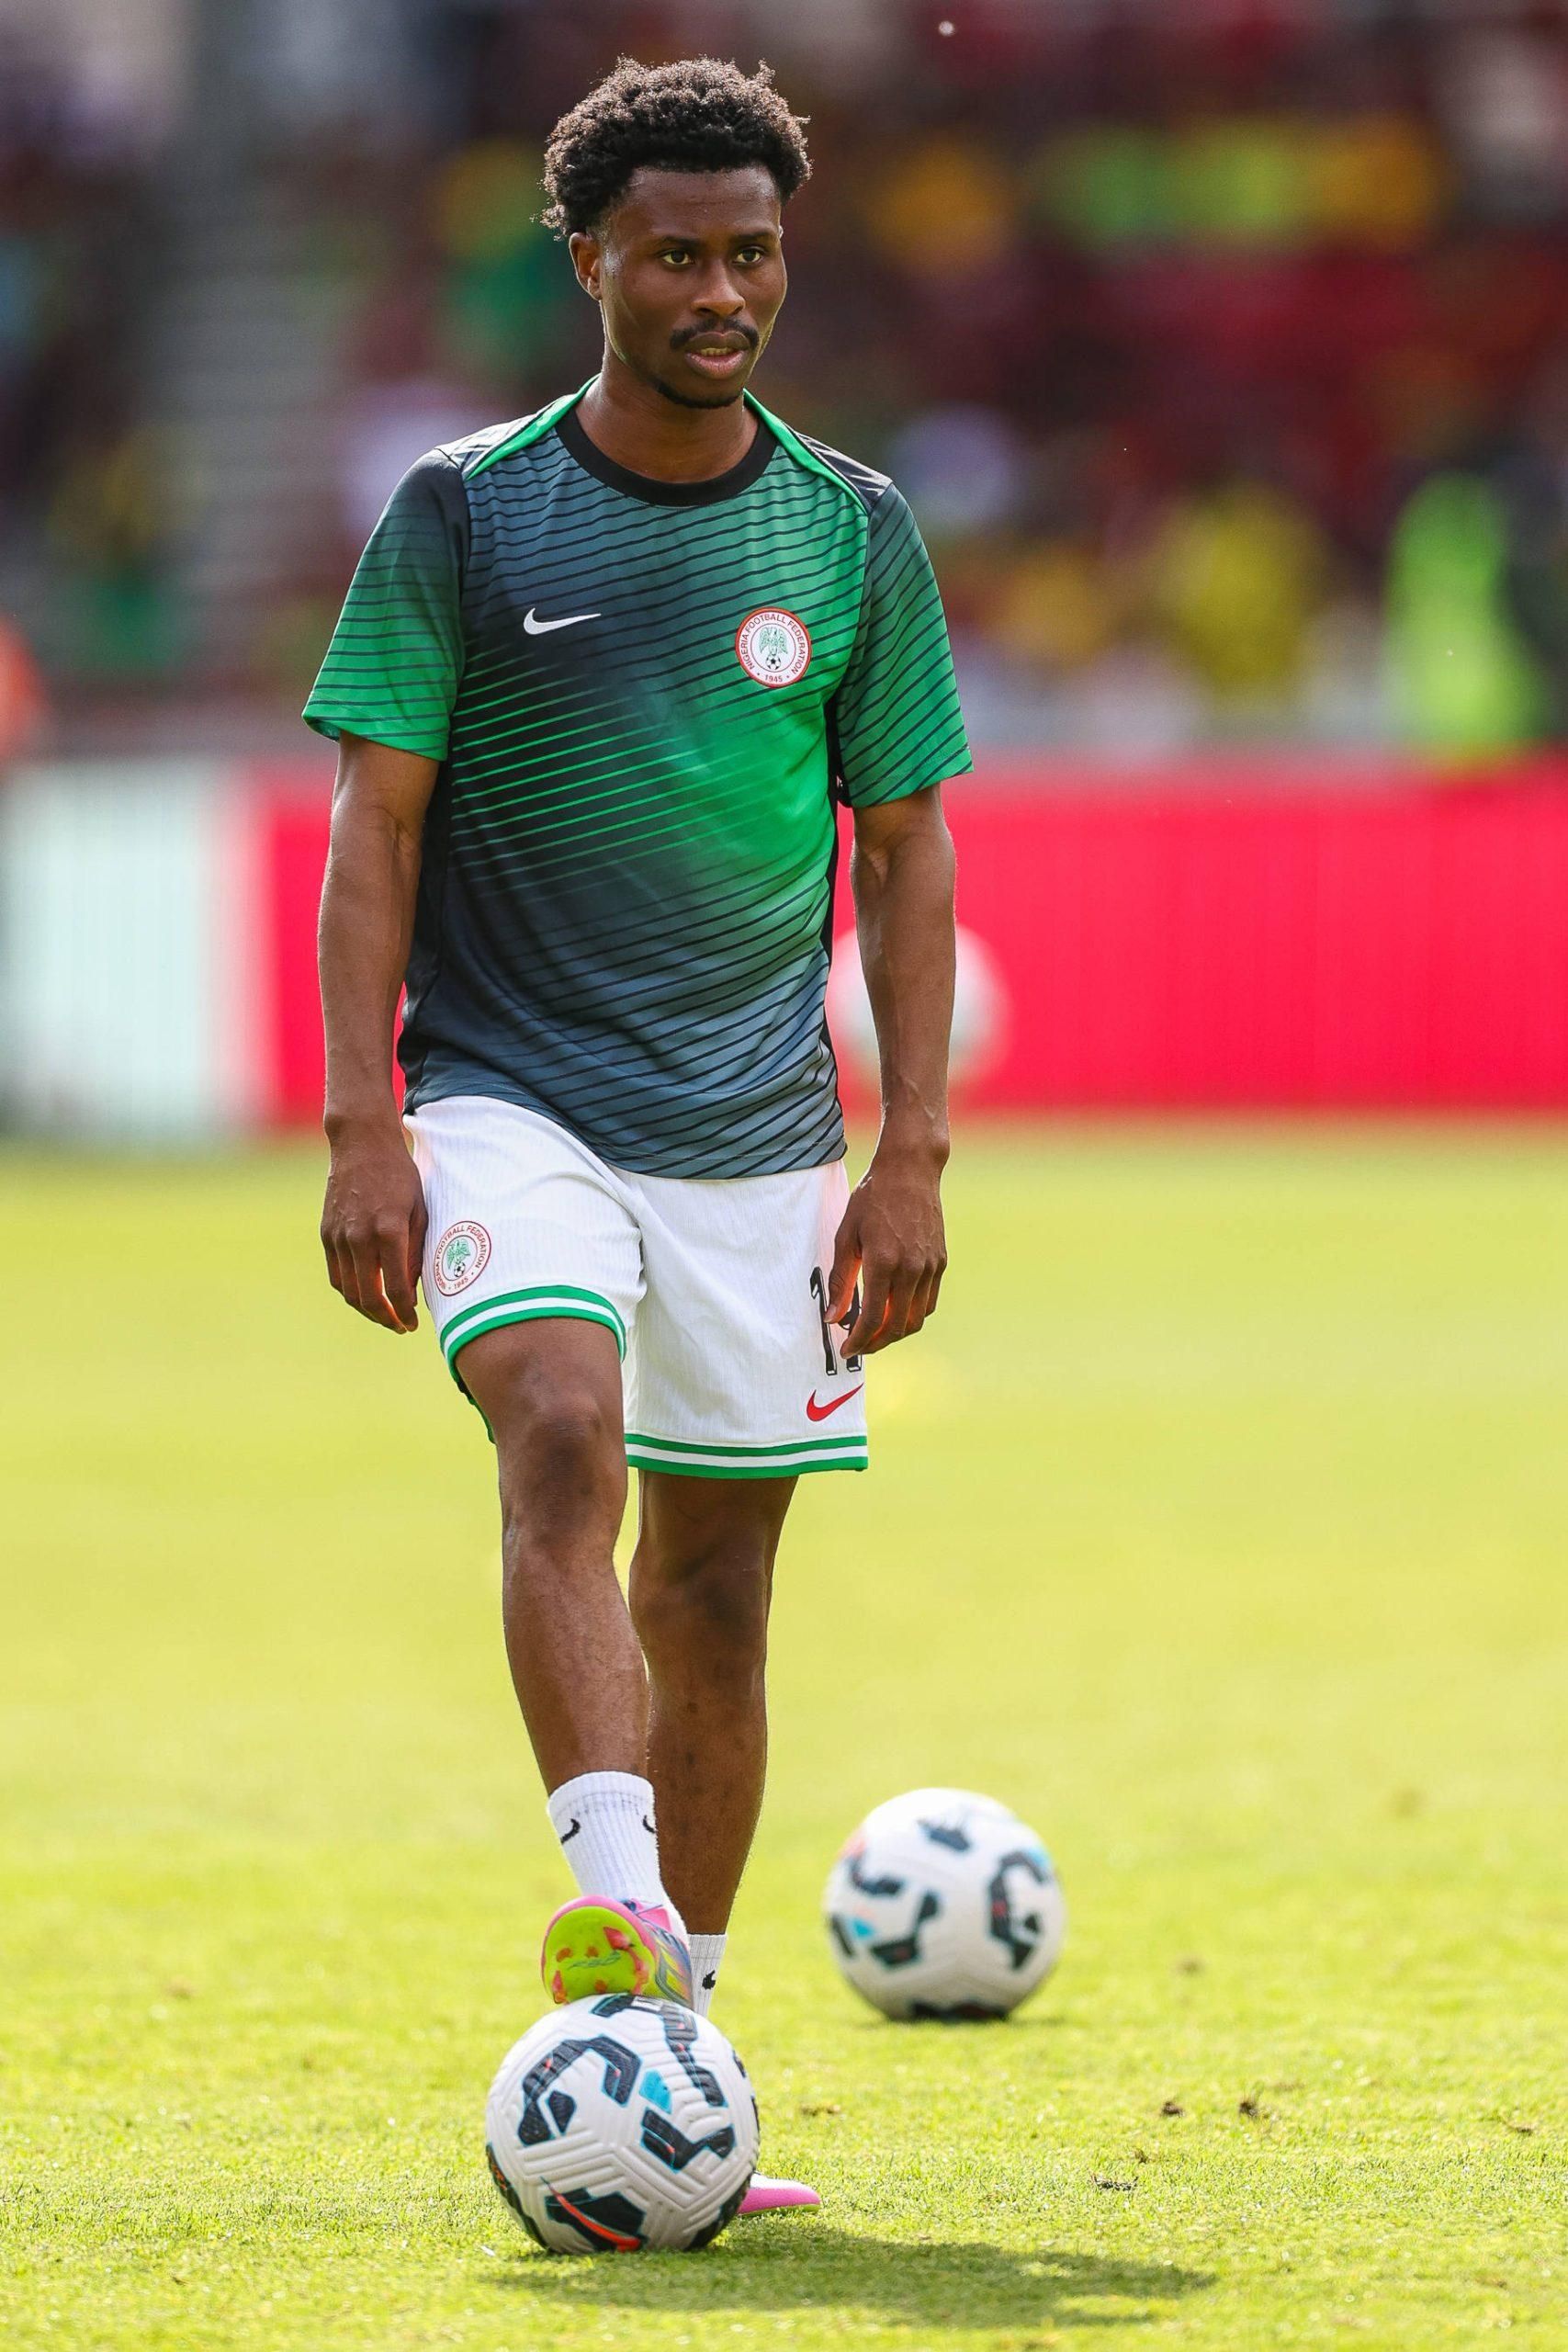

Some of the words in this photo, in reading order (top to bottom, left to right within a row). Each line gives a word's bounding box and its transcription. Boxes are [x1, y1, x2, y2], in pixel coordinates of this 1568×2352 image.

[745, 613, 786, 634] FOOTBALL
[740, 634, 755, 670] NIGERIA
[787, 620, 806, 674] FEDERATION
[764, 674, 784, 683] 1945
